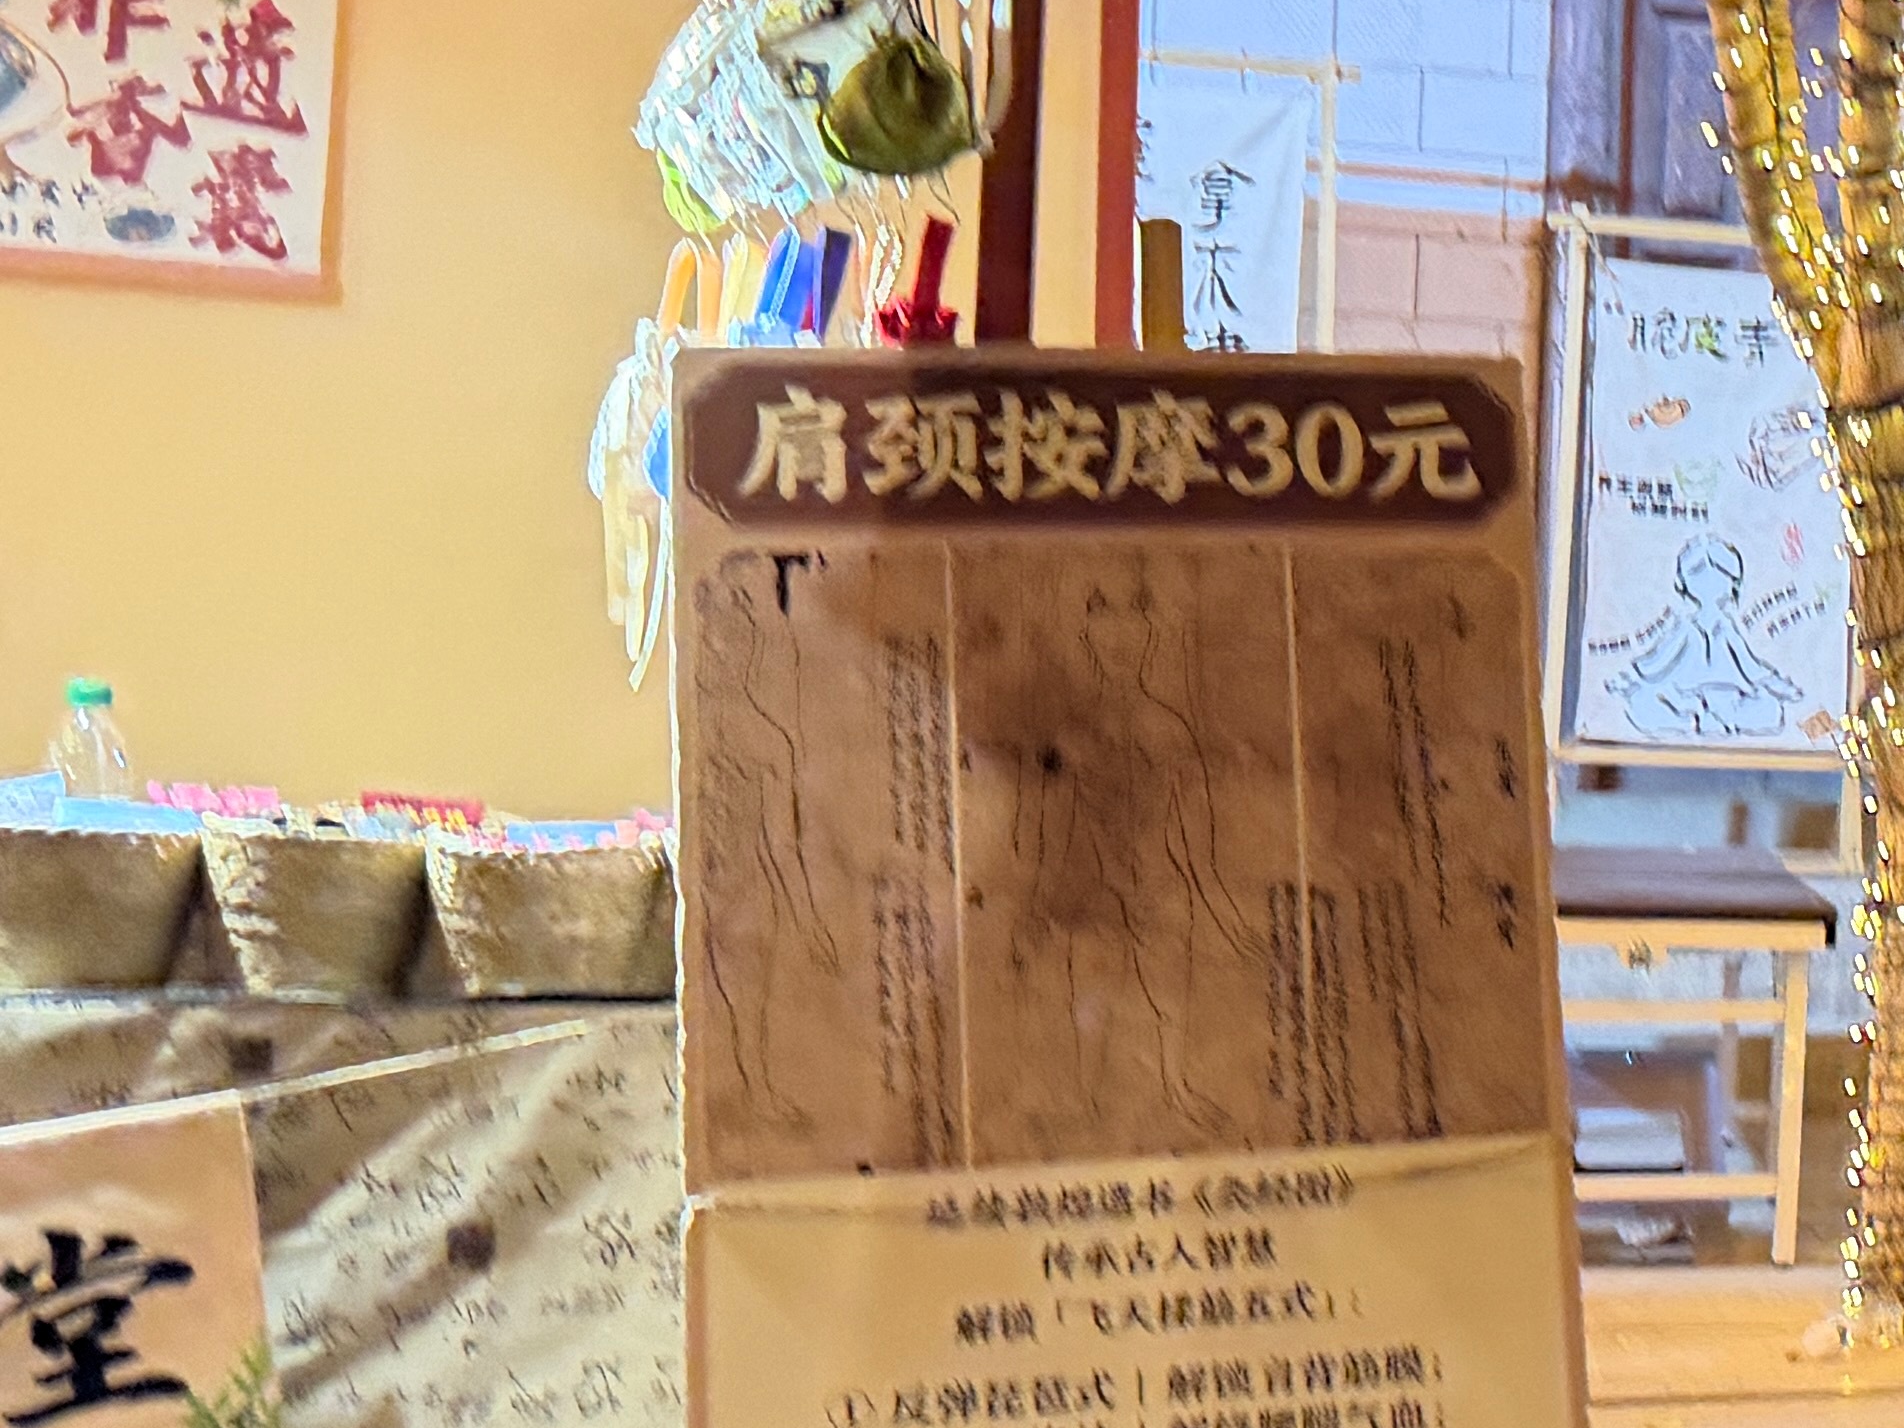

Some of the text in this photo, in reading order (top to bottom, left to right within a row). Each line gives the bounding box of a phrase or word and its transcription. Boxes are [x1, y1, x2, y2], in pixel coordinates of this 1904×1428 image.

[738, 383, 1484, 506] 肩颈按摩30元
[1040, 1225, 1278, 1283] 传承古人智慧
